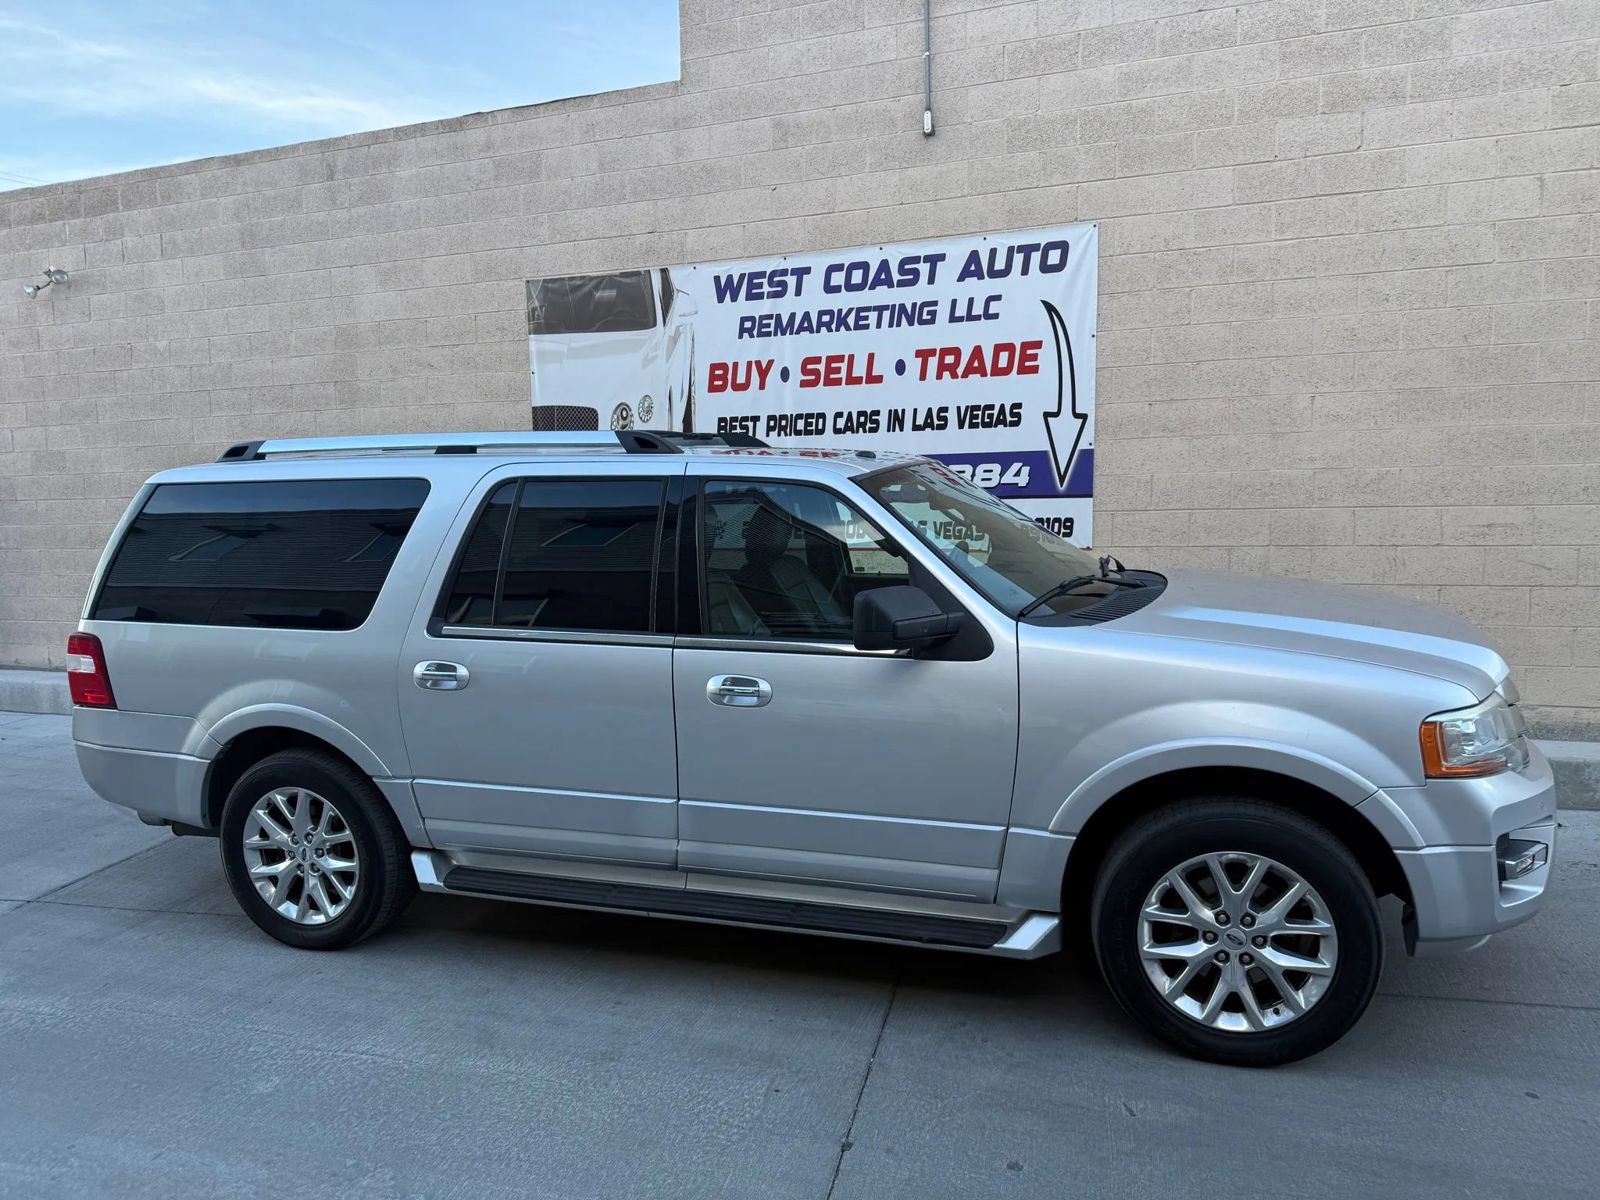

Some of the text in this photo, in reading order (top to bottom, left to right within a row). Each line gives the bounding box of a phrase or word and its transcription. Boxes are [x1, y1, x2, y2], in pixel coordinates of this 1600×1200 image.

[713, 240, 1070, 304] WEST COAST AUTO
[737, 294, 1003, 340] REMARKETING LLC
[707, 340, 1044, 394] BUY SELL TRADE
[717, 402, 1023, 438] BEST PRICED CARS IN LAS VEGAS
